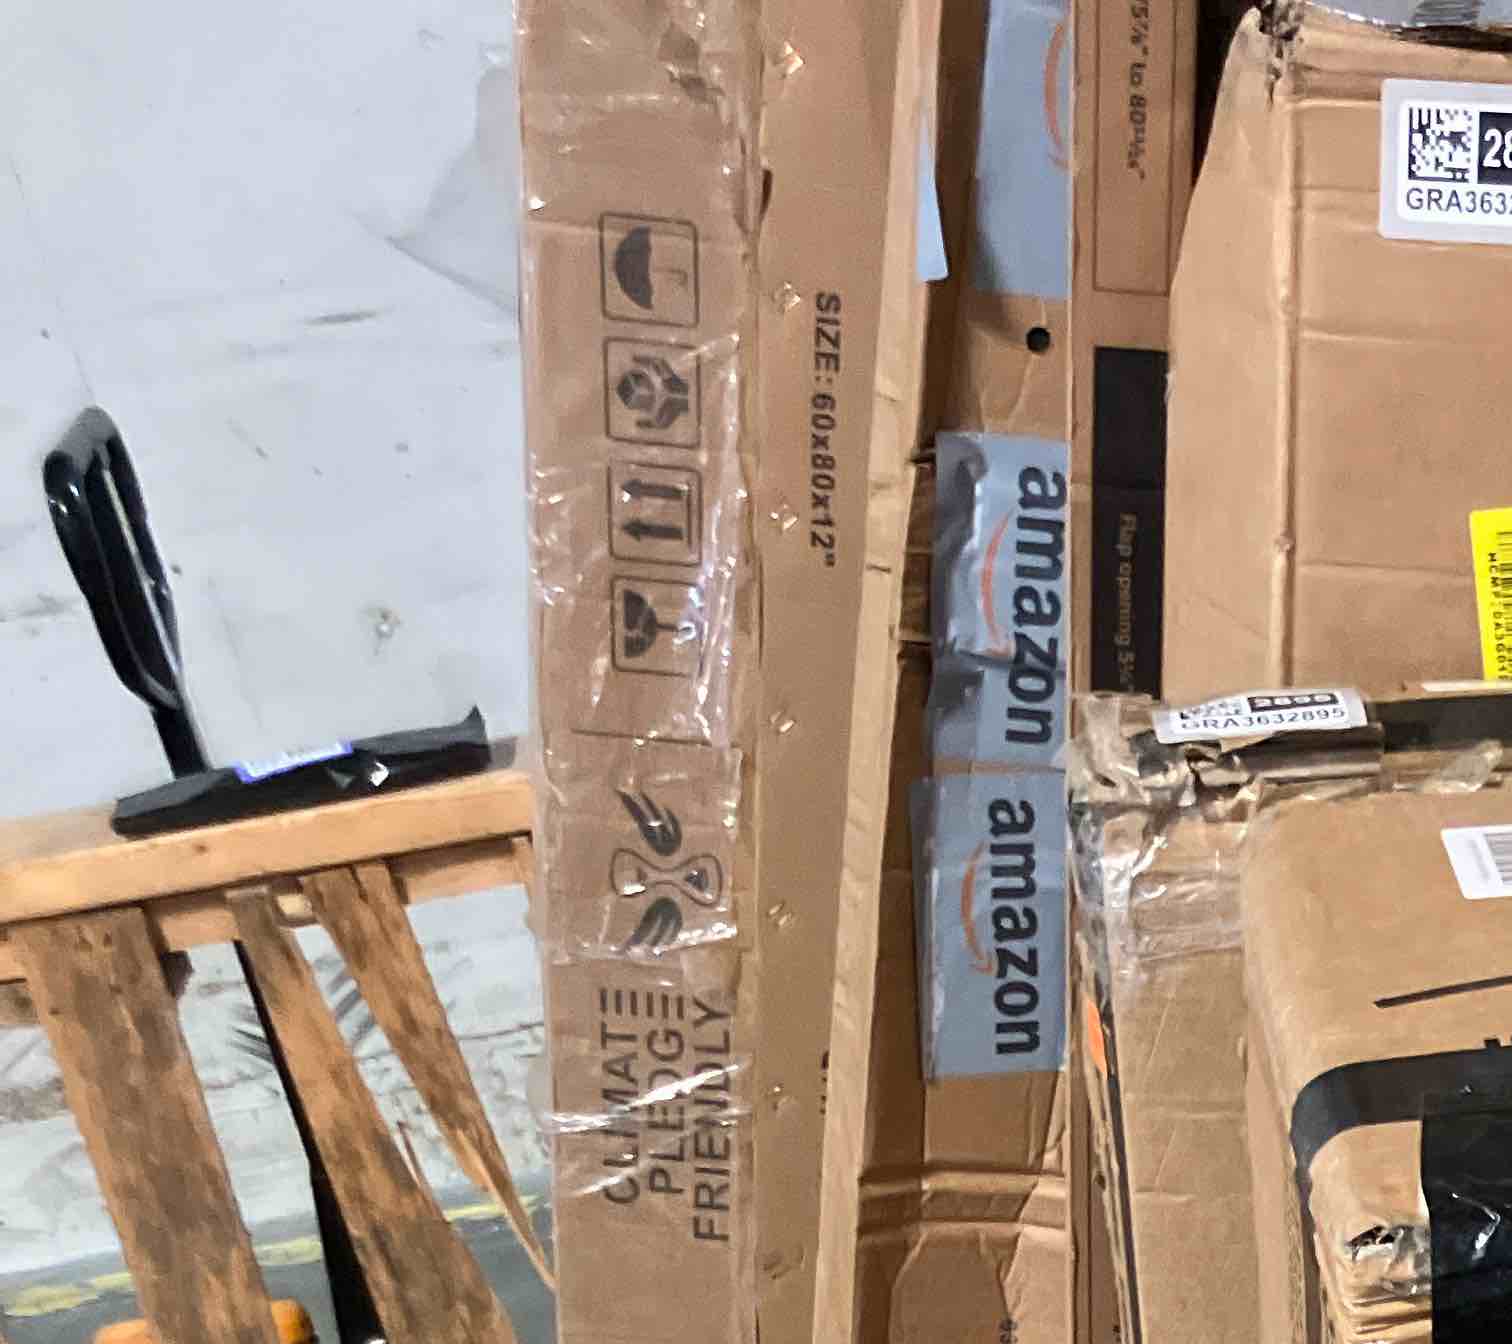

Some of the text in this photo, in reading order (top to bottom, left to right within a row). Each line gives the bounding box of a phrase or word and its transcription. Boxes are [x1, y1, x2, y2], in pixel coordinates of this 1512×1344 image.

[813, 290, 842, 384] SIZE:
[1004, 464, 1068, 744] amazon
[987, 797, 1040, 1056] amazon
[600, 989, 640, 1204] CLIMATE
[646, 989, 686, 1195] PLEDGE
[691, 997, 732, 1243] FRIENDLY
